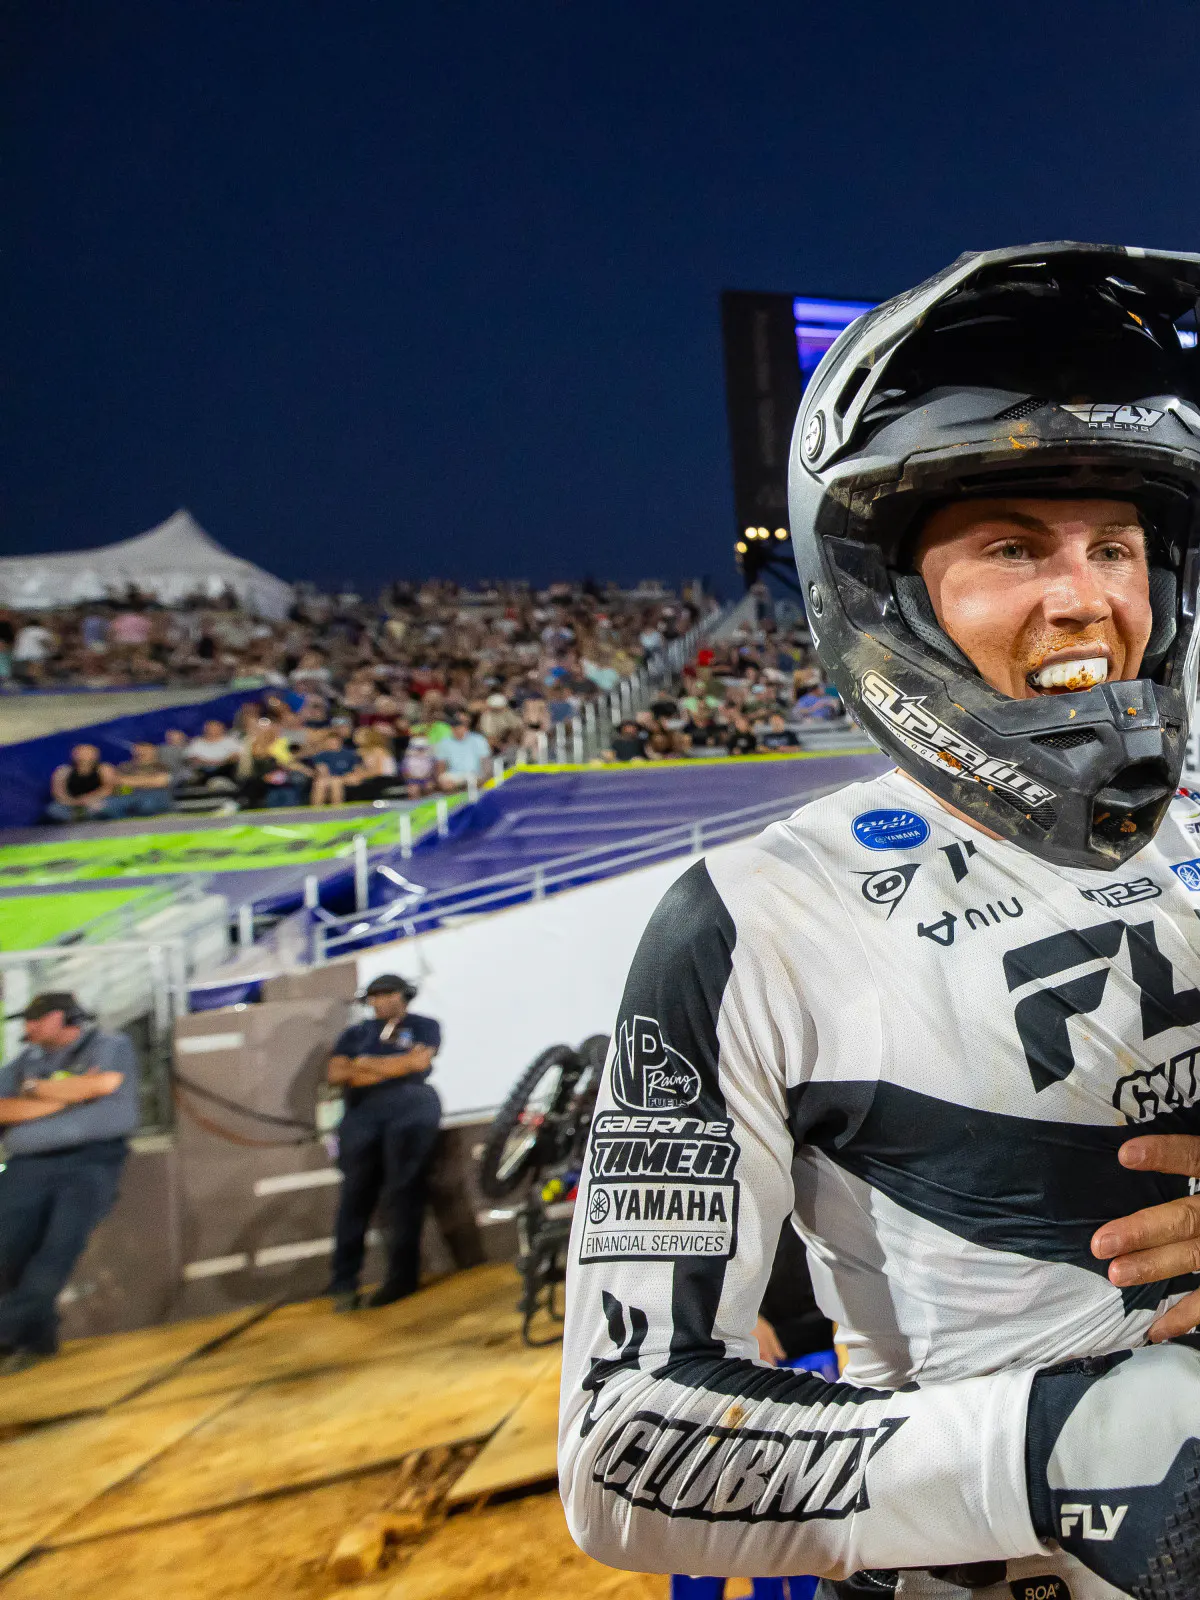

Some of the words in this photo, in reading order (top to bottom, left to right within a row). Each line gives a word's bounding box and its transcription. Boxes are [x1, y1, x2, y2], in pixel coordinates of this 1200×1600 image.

[1062, 403, 1164, 427] FLY
[1088, 422, 1150, 432] RACING
[863, 671, 1054, 805] SUPERLITE
[885, 830, 922, 842] YAMAHA
[648, 1070, 698, 1097] Racing
[648, 1098, 689, 1108] FUELS
[593, 1138, 736, 1178] TAMER
[613, 1189, 727, 1222] YAMAHA
[586, 1235, 648, 1254] FINANCIAL
[651, 1235, 724, 1252] SERVICES
[593, 1413, 910, 1522] CLUBMX
[1060, 1503, 1129, 1541] FLY
